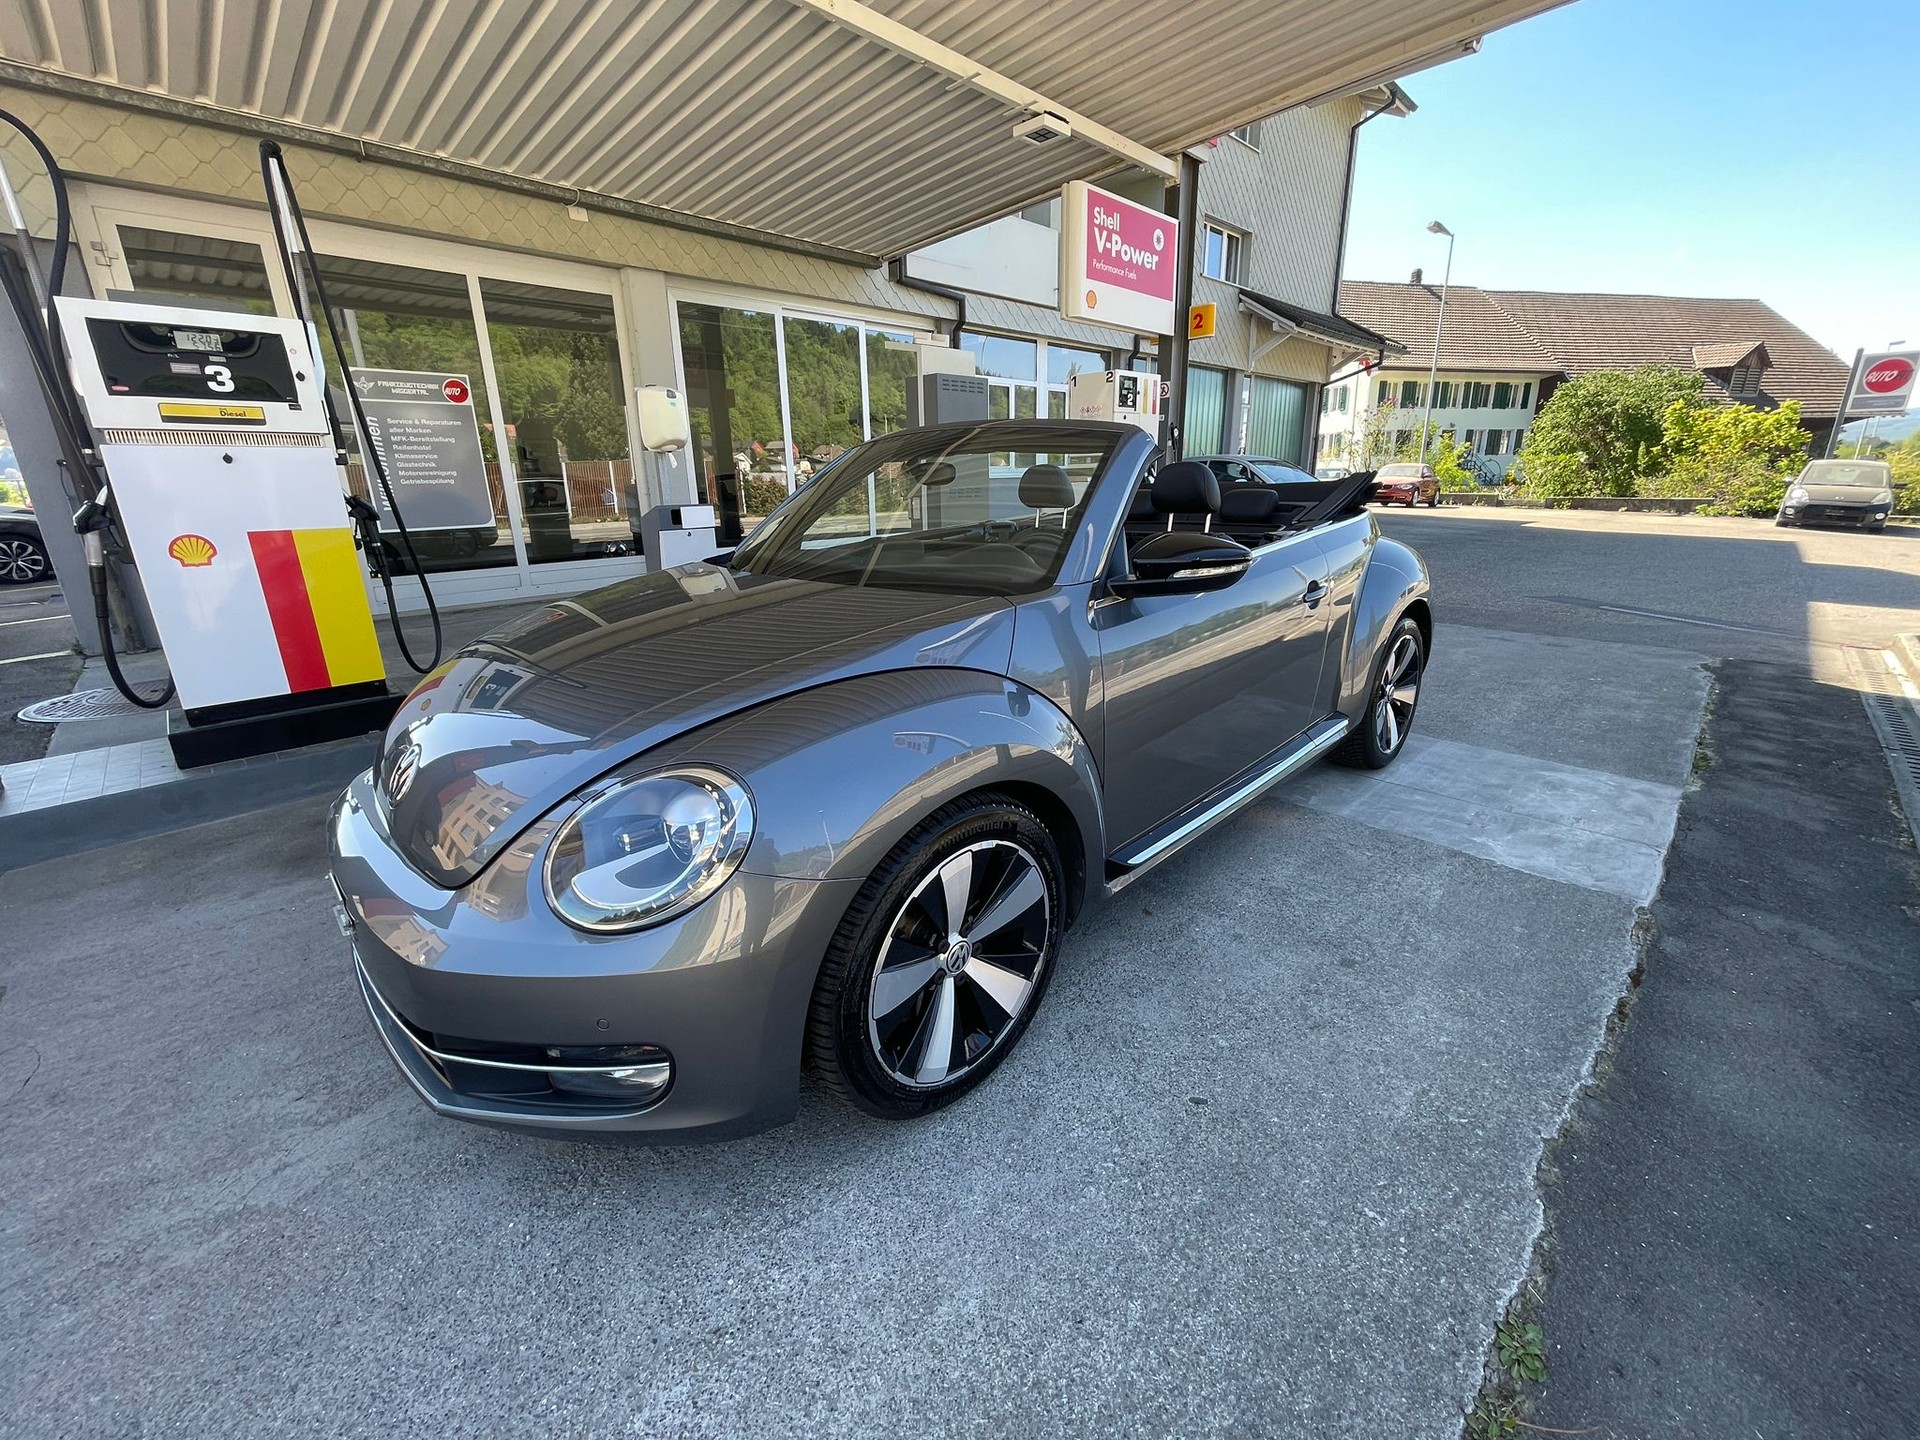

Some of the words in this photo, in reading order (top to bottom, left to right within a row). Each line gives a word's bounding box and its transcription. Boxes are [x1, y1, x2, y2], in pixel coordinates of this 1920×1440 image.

[1093, 206, 1120, 232] Shell
[1094, 226, 1159, 271] V-Power
[1092, 258, 1125, 276] Performance
[1125, 267, 1137, 280] Fuels
[1193, 313, 1204, 330] 2
[204, 364, 236, 393] 3
[1071, 376, 1077, 387] 1
[1105, 371, 1114, 383] 2
[1127, 393, 1134, 406] 2
[386, 417, 413, 425] Service
[421, 418, 462, 426] Reparaturen
[390, 435, 456, 443] MFK-Bereitstellung
[398, 469, 457, 477] Motorenreinigung
